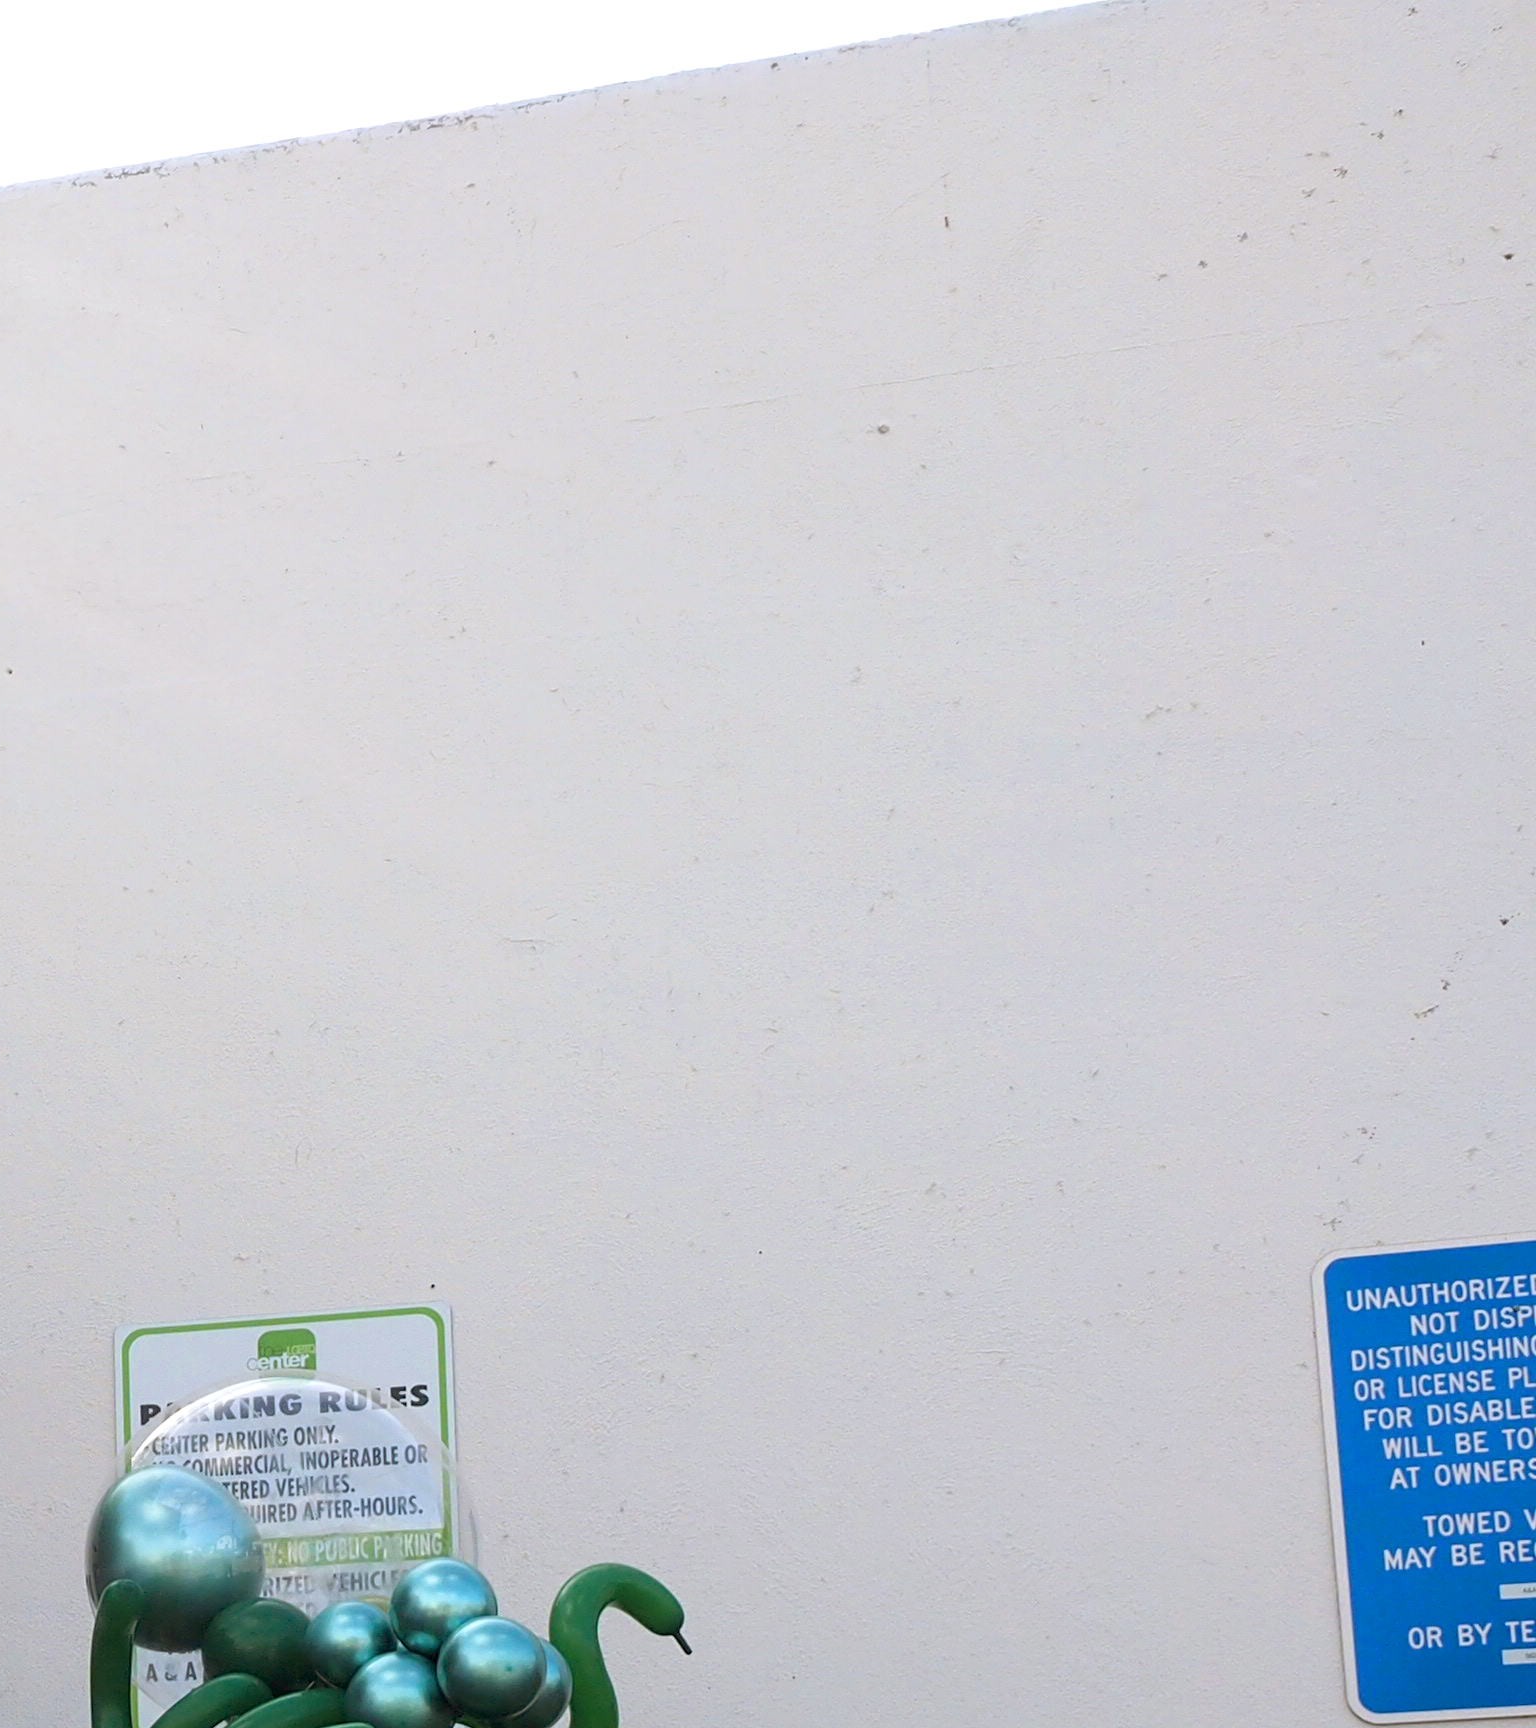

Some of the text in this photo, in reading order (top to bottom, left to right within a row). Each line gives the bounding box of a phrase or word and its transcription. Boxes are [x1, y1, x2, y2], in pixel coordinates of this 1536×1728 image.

[1410, 1311, 1460, 1336] NOT
[247, 1352, 310, 1371] center
[1354, 1378, 1385, 1401] OR
[1398, 1369, 1496, 1398] LICENSE
[140, 1384, 429, 1426] PKING RULES
[1363, 1406, 1413, 1431] FOR
[152, 1425, 339, 1456] CENTER PARKING ONLY.
[1382, 1427, 1536, 1460] WILL BE TO
[183, 1444, 428, 1477] OMMERCIAL, INOPERABLE OR
[275, 1474, 356, 1498] VEHICLES.
[1390, 1466, 1420, 1490] AT
[303, 1495, 423, 1520] AFTER-HOURS.
[1422, 1510, 1511, 1538] TOWED
[288, 1541, 309, 1564] NO
[316, 1536, 368, 1562] PUBLIC
[374, 1532, 443, 1558] PKING
[1383, 1539, 1536, 1571] MAY BE RE
[1408, 1626, 1443, 1650] OR
[1457, 1623, 1492, 1646] BY
[146, 1663, 158, 1682] A
[185, 1661, 197, 1681] A
